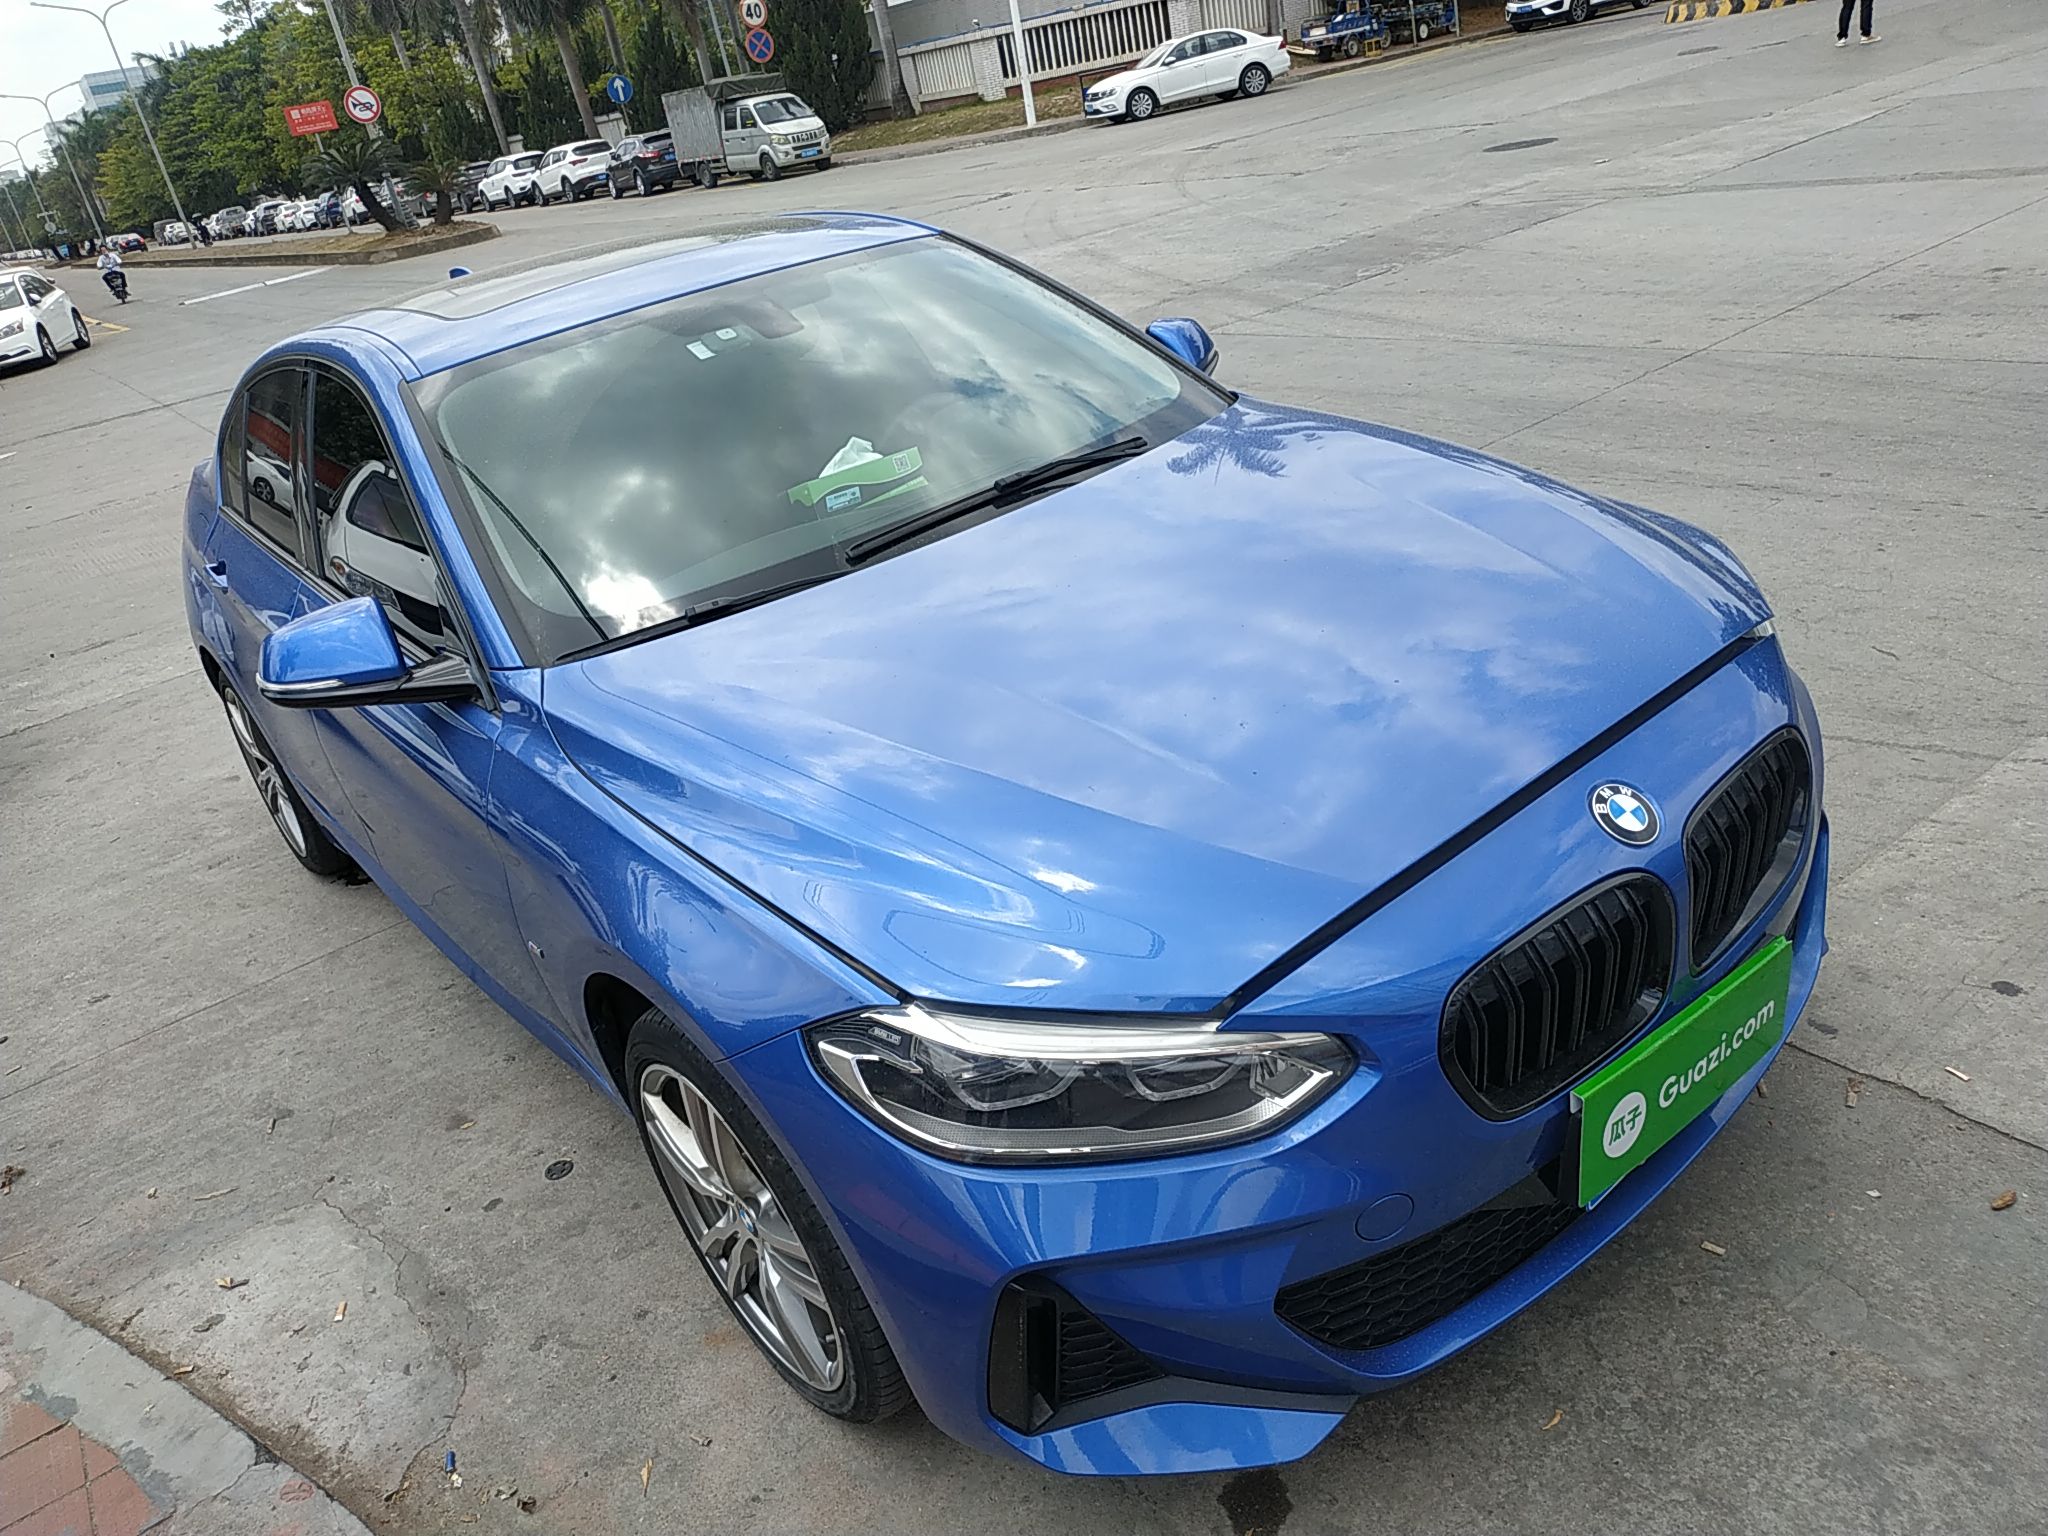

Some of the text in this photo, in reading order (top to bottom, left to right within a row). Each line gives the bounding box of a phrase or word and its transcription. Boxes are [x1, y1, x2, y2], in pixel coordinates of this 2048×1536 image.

[745, 3, 761, 19] 40
[1595, 786, 1632, 814] BMW
[1608, 1000, 1775, 1146] 瓜子 Guazi.com
